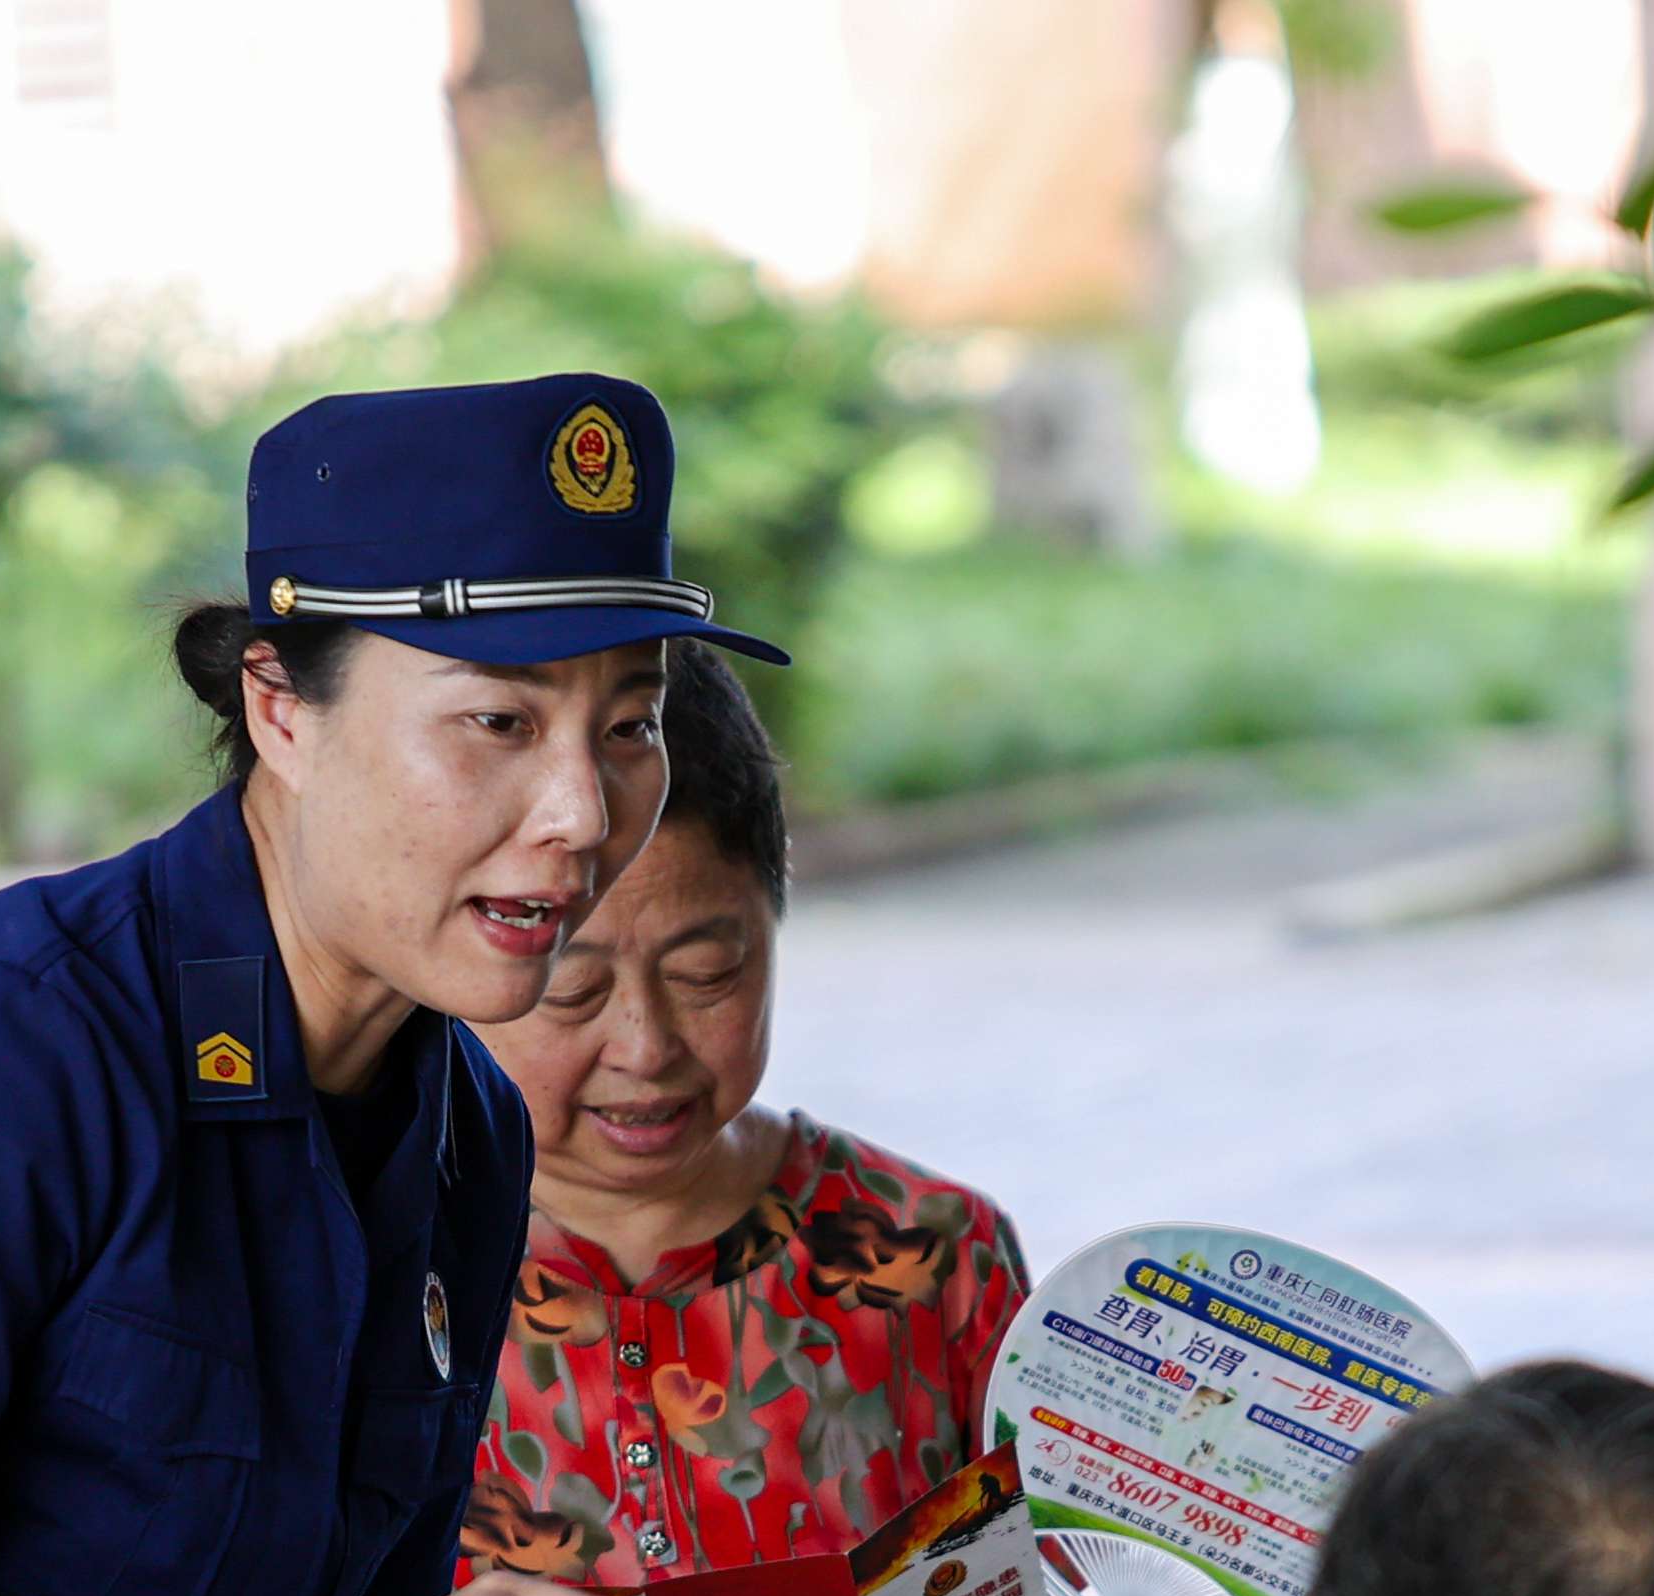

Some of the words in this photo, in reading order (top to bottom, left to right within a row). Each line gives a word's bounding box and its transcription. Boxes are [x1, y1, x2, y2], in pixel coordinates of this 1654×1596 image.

[1266, 1263, 1413, 1339] 重庆仁同肛肠医院
[1107, 1471, 1181, 1514] 8607
[1177, 1502, 1250, 1547] 9898
